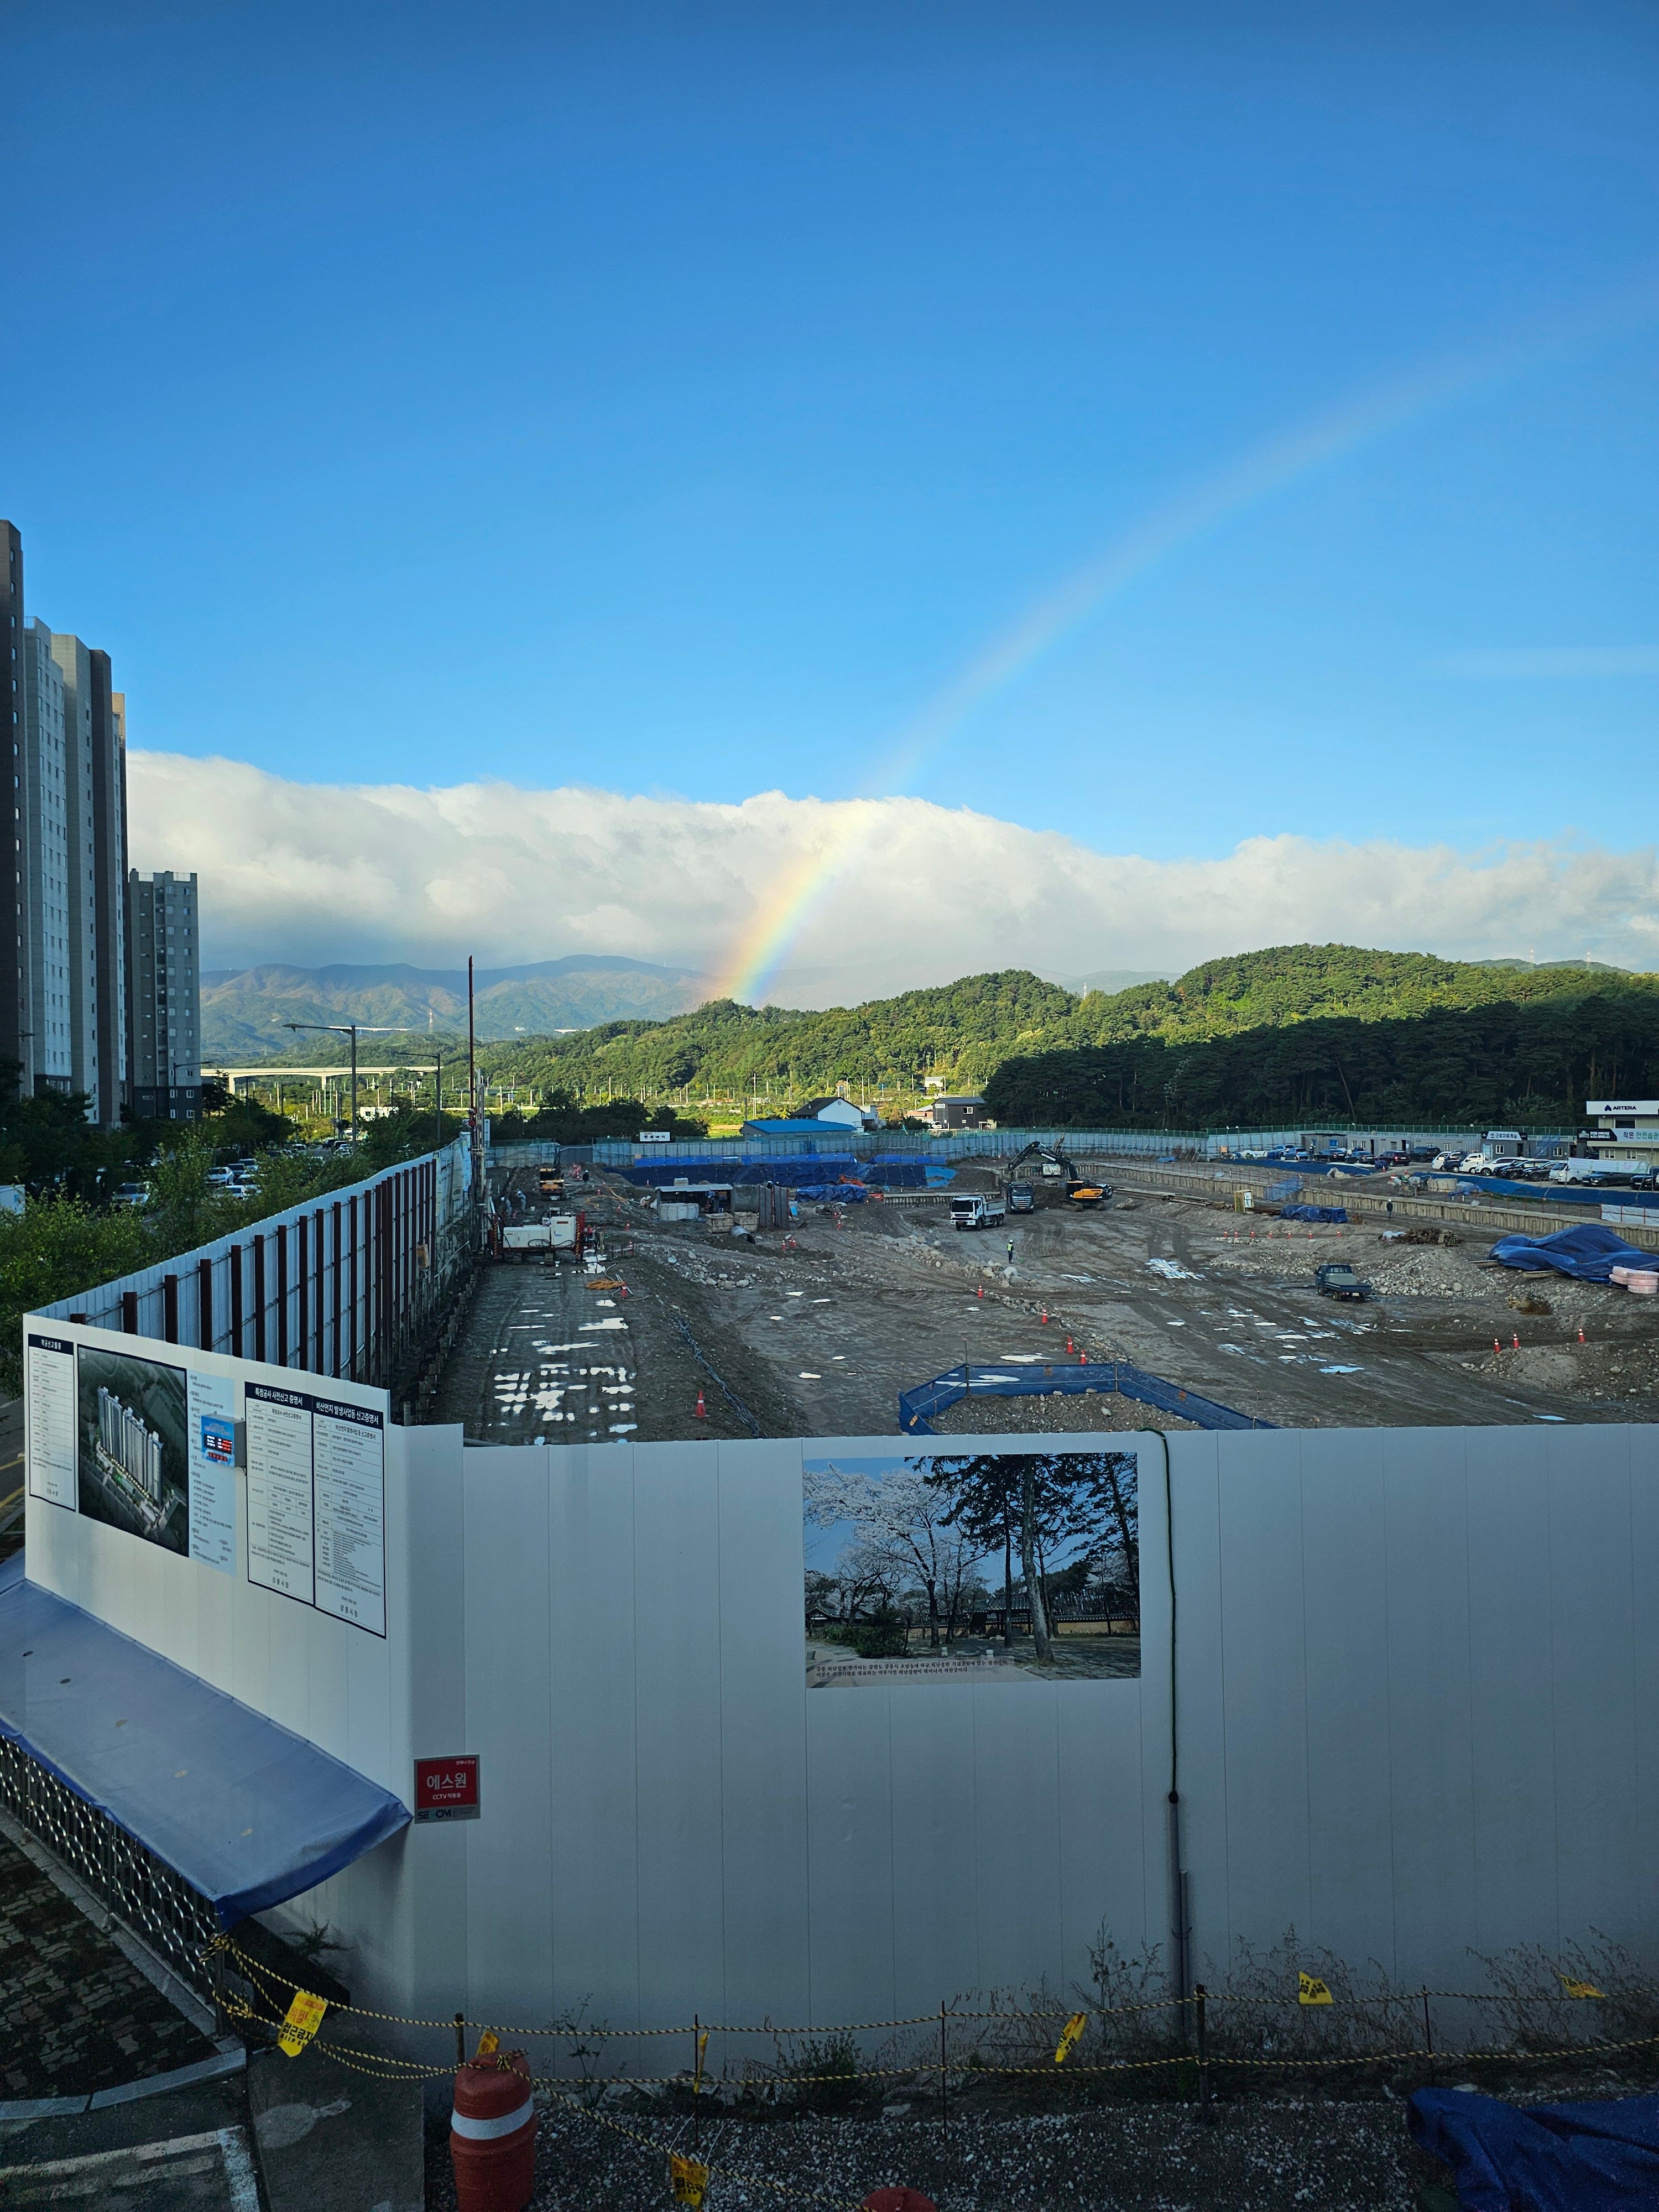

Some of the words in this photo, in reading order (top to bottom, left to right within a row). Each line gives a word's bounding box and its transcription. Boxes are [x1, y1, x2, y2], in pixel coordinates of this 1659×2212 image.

[255, 1387, 272, 1399] 특정공사
[272, 1390, 289, 1402] 사전신고
[289, 1394, 302, 1406] 증명서
[316, 1401, 333, 1414] 비산먼지
[334, 1405, 356, 1419] 발생사업등
[356, 1410, 379, 1425] 신고증명서
[426, 1772, 467, 1790] 에스원
[418, 1809, 452, 1820] SEOM
